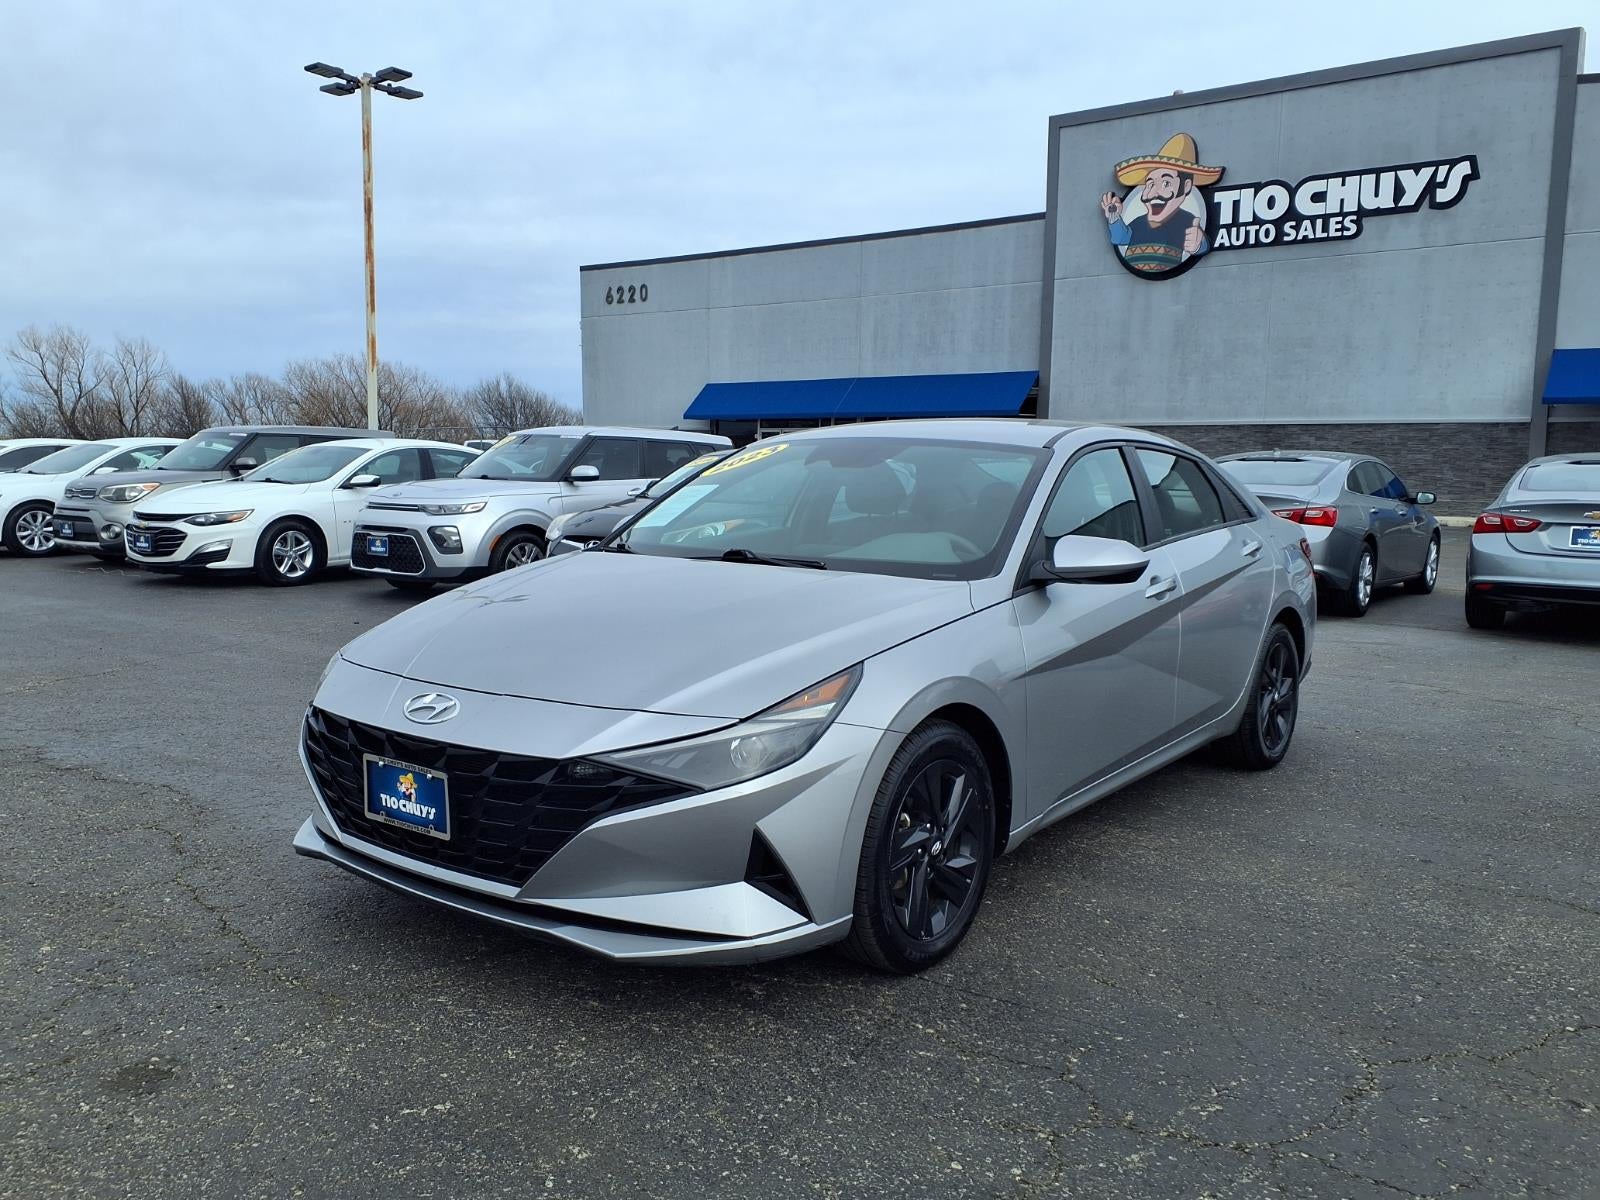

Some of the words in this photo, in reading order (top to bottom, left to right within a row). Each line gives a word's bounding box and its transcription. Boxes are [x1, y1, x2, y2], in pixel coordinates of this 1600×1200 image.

[1214, 184, 1290, 225] TIO
[1295, 160, 1472, 216] CHUY'S
[1214, 223, 1276, 248] AUTO
[1283, 215, 1358, 241] SALES
[605, 283, 648, 305] 6220
[380, 793, 399, 810] TIO
[399, 799, 436, 820] CHUY'S
